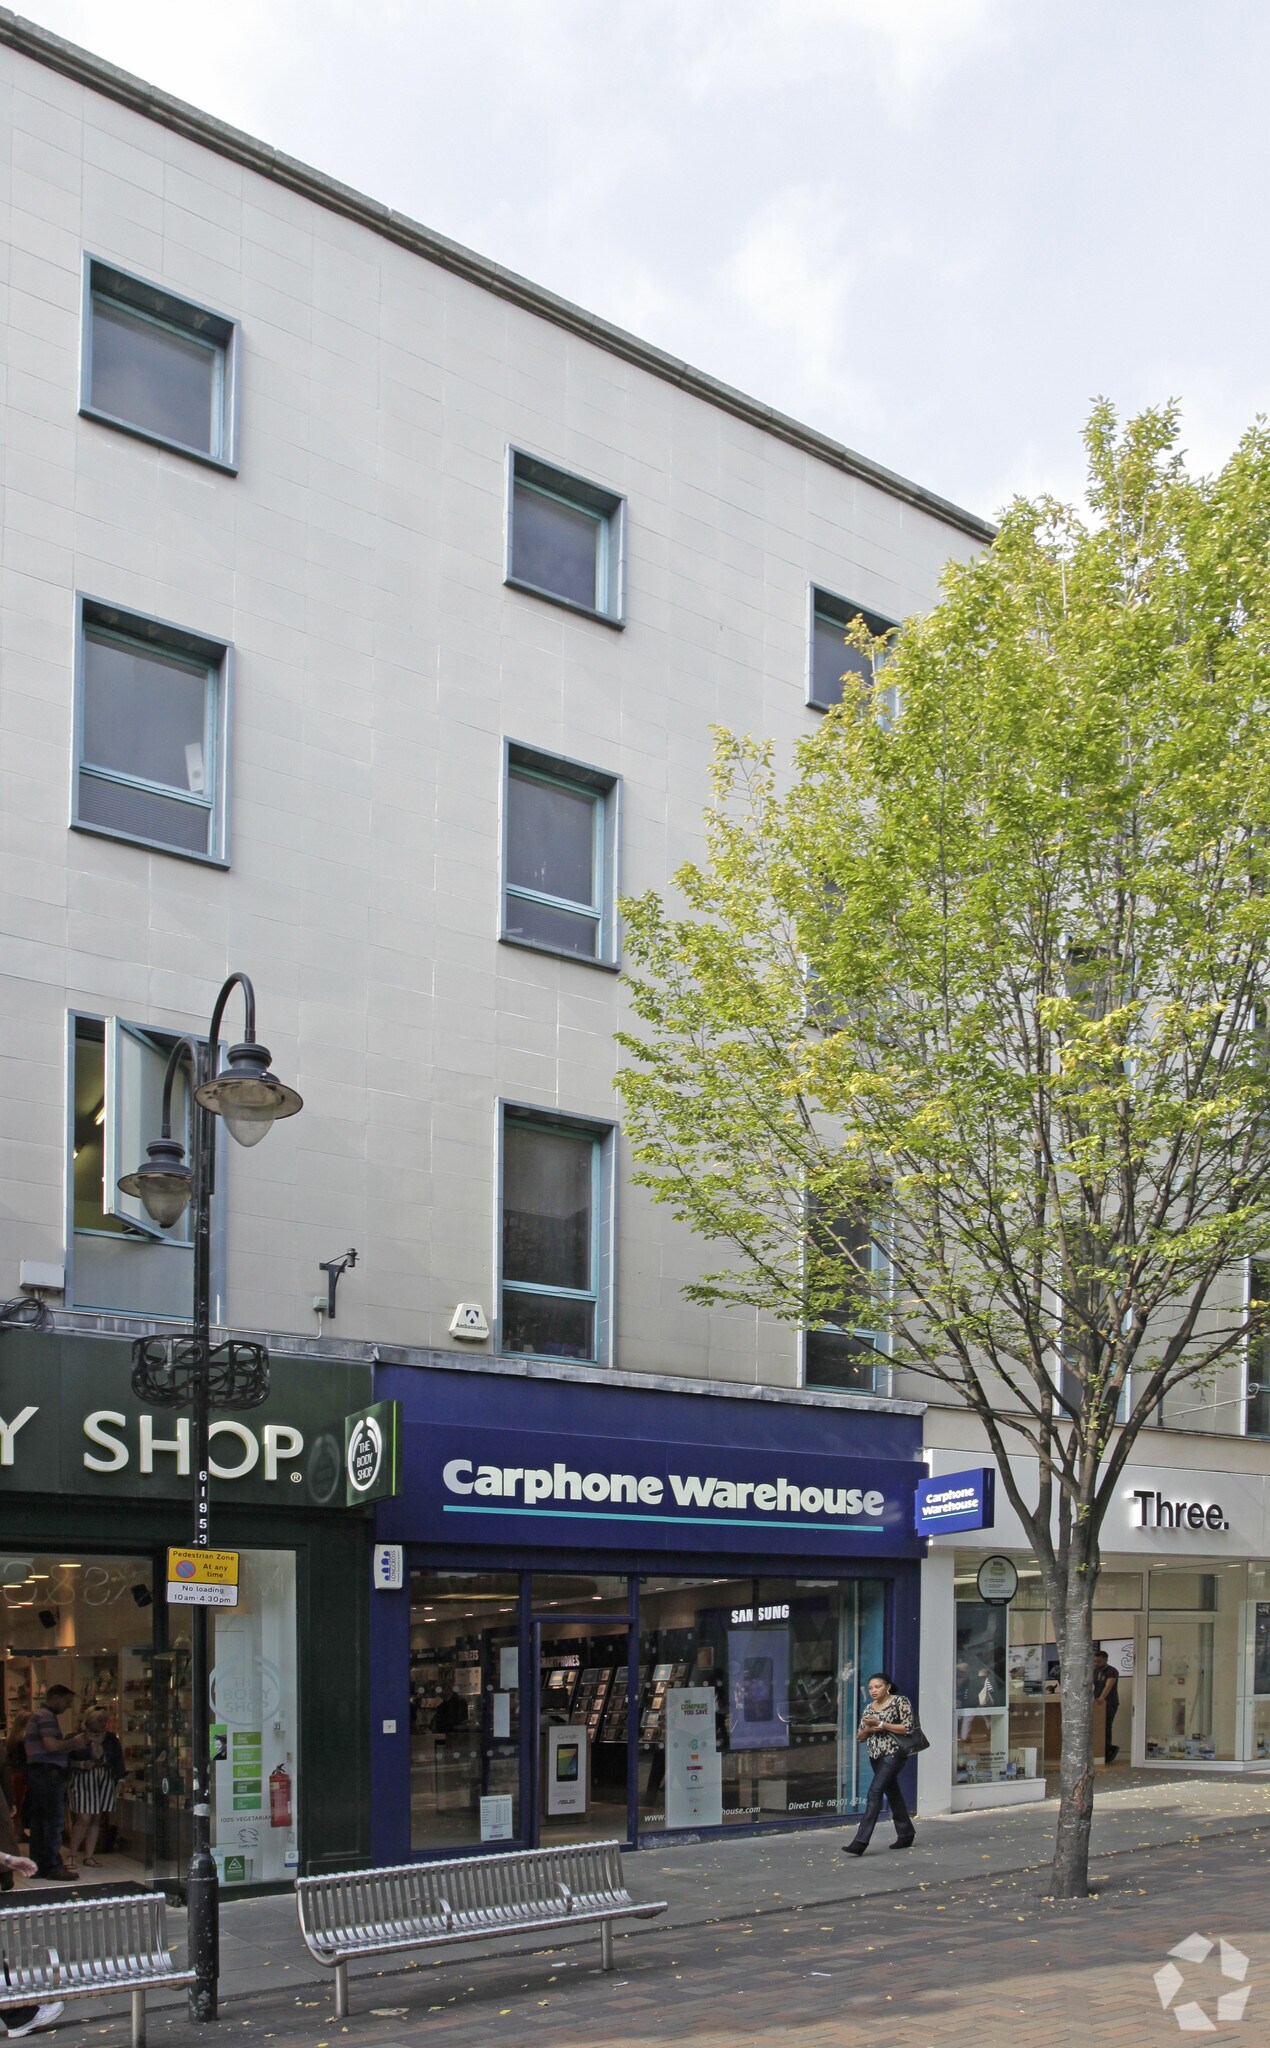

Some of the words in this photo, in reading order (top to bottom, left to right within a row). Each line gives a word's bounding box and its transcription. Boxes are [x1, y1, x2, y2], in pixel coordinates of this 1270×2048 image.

[456, 1323, 488, 1331] Ambassador
[83, 1410, 304, 1481] SHOP
[359, 1440, 370, 1454] THE
[356, 1453, 373, 1468] BODY
[357, 1466, 373, 1481] SHOP
[442, 1459, 664, 1504] Carphone
[668, 1475, 885, 1516] Warehouse
[926, 1487, 975, 1504] Carphone
[199, 1470, 207, 1545] 61953
[922, 1499, 979, 1516] Warehouse
[1133, 1490, 1230, 1530] Three.
[173, 1551, 213, 1560] Pedestrian
[216, 1553, 235, 1561] Zone
[197, 1586, 224, 1595] loading
[458, 1650, 479, 1661] TABLETS
[226, 1701, 269, 1713] SHOP
[788, 1802, 809, 1811] Direct
[811, 1800, 824, 1808] Tel:
